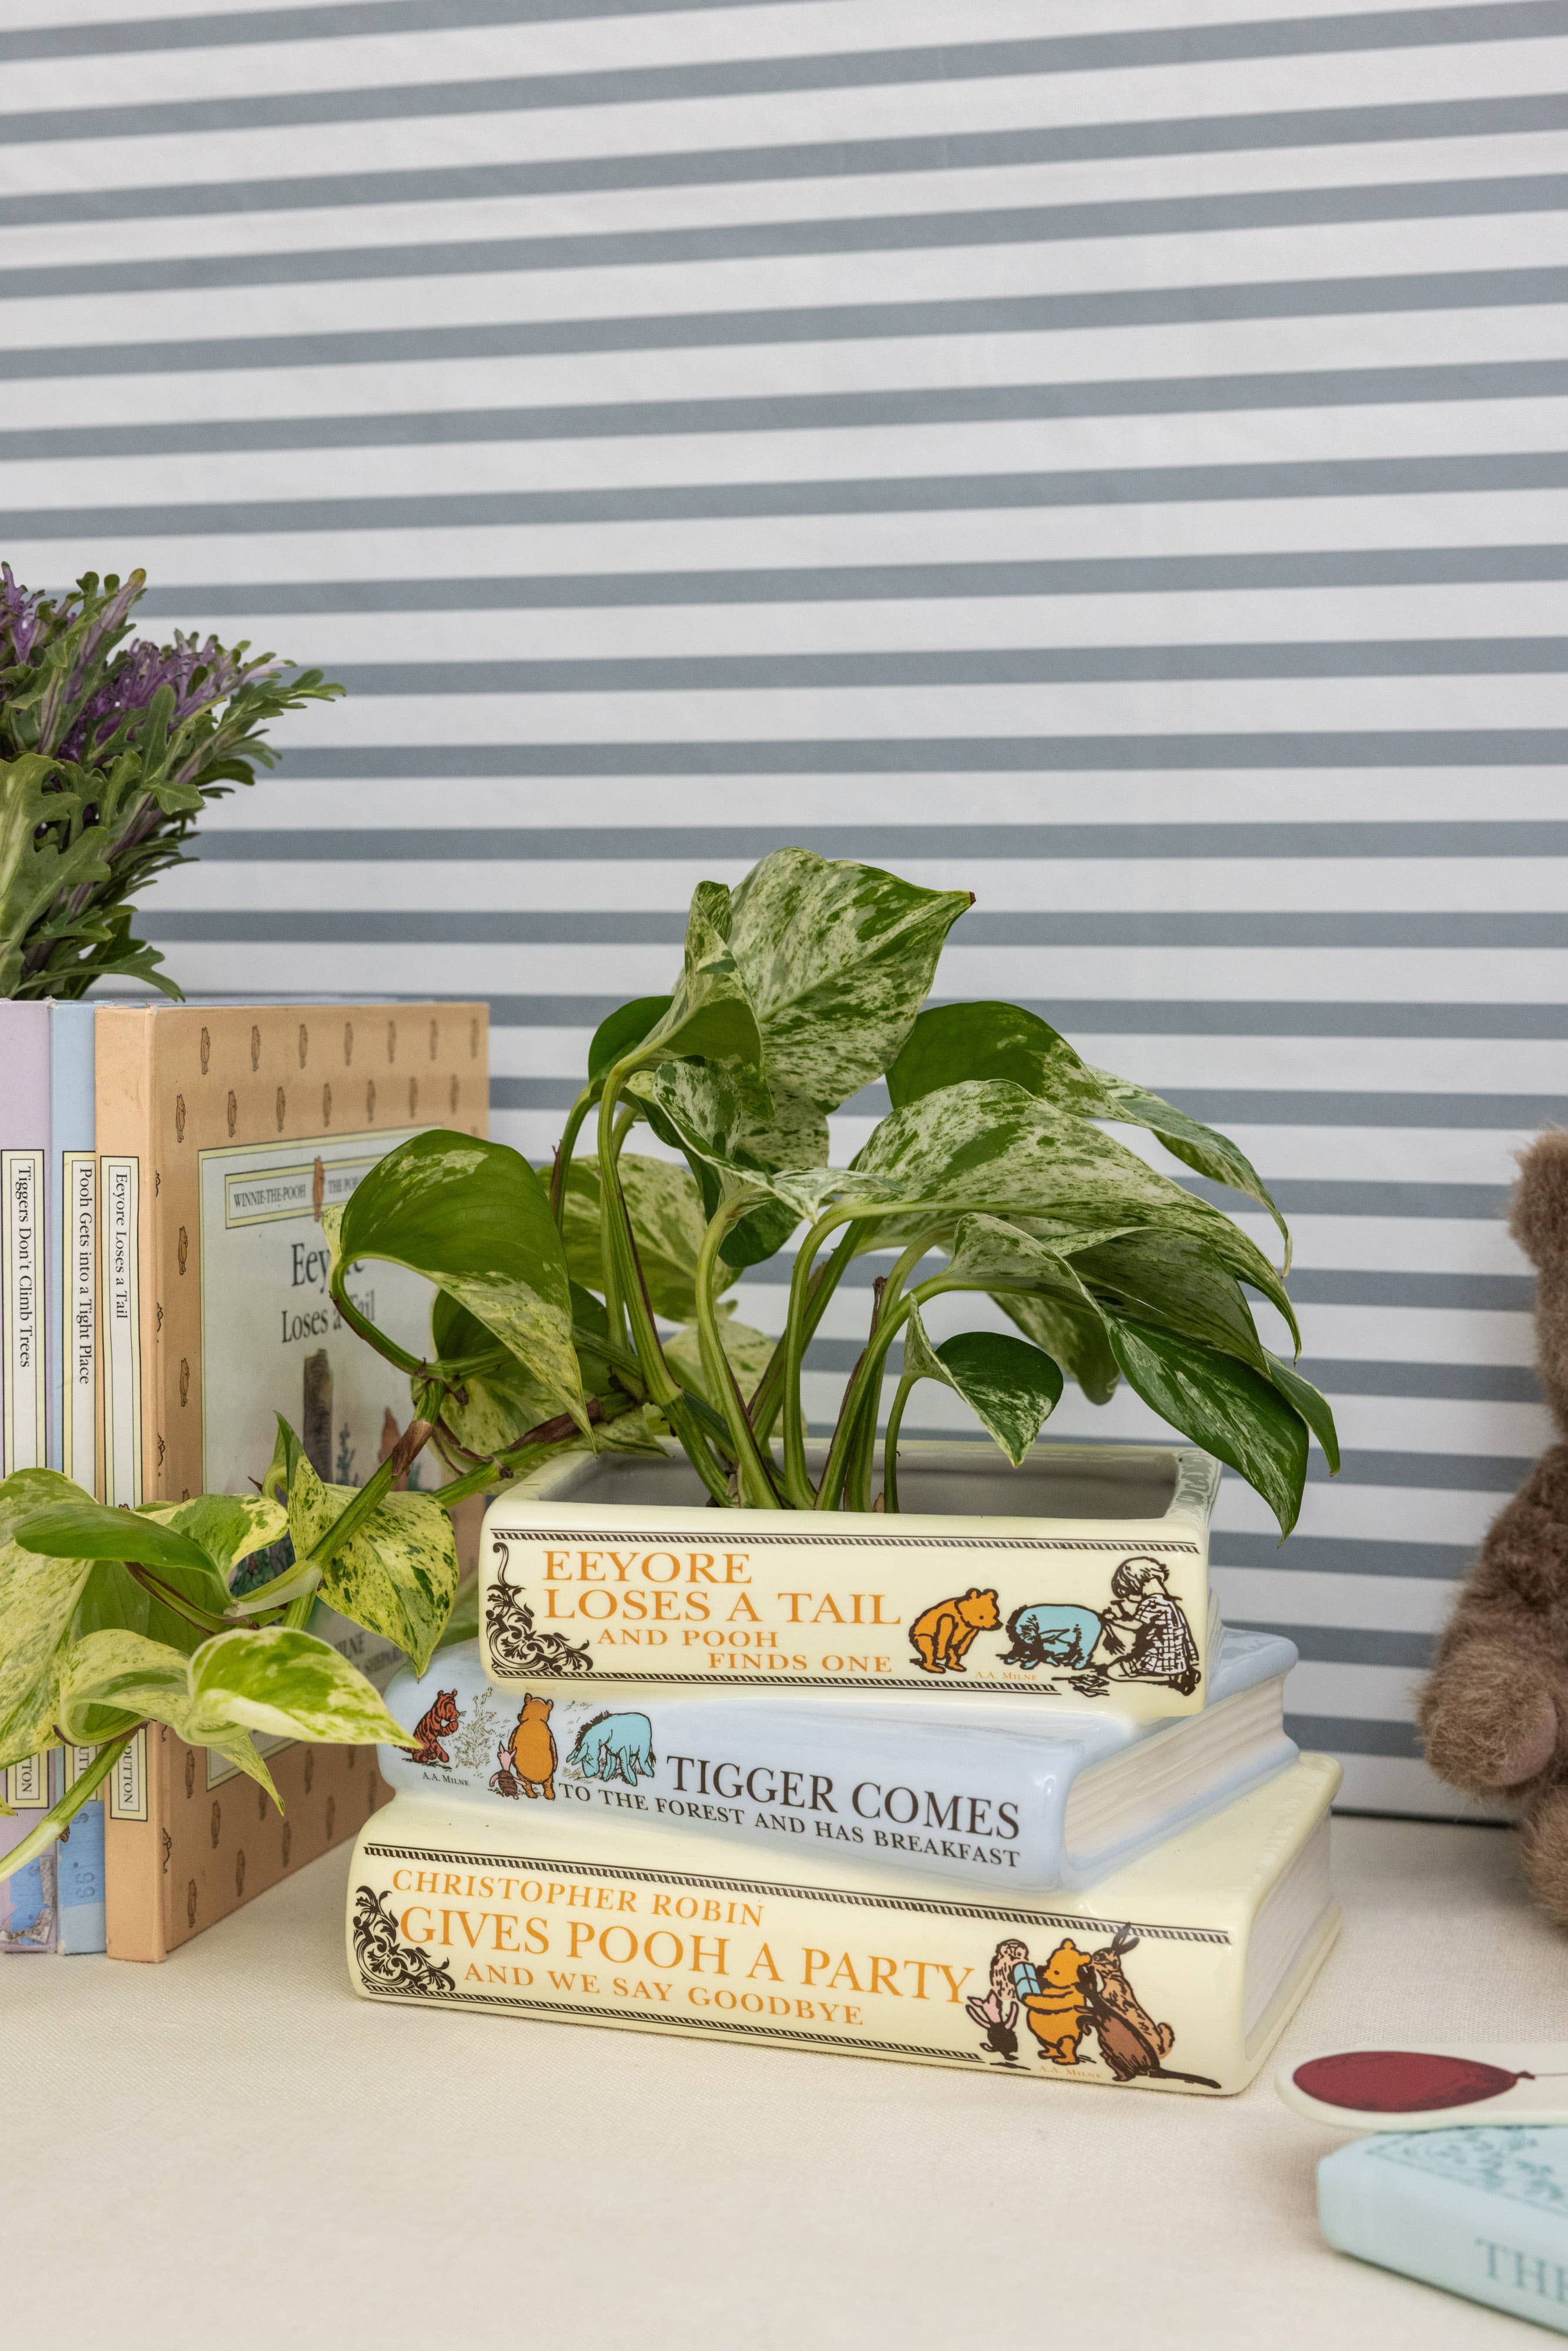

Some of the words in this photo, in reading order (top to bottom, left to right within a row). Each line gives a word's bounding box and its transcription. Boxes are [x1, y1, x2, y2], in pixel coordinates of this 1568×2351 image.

[15, 1166, 32, 1223] Tiggers
[79, 1167, 93, 1208] Pooh
[113, 1173, 128, 1226] Eeyore
[233, 1184, 306, 1208] WINNIE-THE-POOH
[79, 1212, 92, 1247] Gets
[79, 1251, 92, 1282] into
[115, 1231, 127, 1273] Loses
[19, 1275, 33, 1321] Climb
[79, 1286, 89, 1295] a
[115, 1278, 125, 1286] a
[76, 1298, 93, 1340] Tight
[116, 1290, 128, 1319] Tail
[282, 1307, 329, 1344] Loses
[20, 1325, 33, 1368] Trees
[79, 1344, 92, 1385] Place
[542, 1550, 752, 1585] EEYORE
[544, 1589, 711, 1622] LOSES
[726, 1592, 763, 1623] A
[778, 1593, 901, 1625] TAIL
[597, 1628, 668, 1646] AND
[682, 1629, 779, 1648] POOH
[708, 1652, 808, 1671] FINDS
[822, 1655, 892, 1673] ONE
[423, 1771, 441, 1782] A.A.
[666, 1755, 839, 1814] TIGGER
[852, 1781, 1020, 1840] COMES
[558, 1783, 591, 1802] TO
[598, 1789, 649, 1811] THE
[656, 1797, 746, 1826] FOREST
[754, 1812, 806, 1834] AND
[815, 1821, 865, 1844] HAS
[874, 1830, 1020, 1867] BREAKFAST
[392, 1868, 638, 1913] CHRISTOPHER
[651, 1893, 765, 1927] ROBIN
[400, 1906, 550, 1955] GIVES
[566, 1921, 732, 1975] POOH
[745, 1942, 785, 1983] A
[800, 1947, 976, 2004] PARTY
[463, 1962, 535, 1986] AND
[547, 1970, 600, 1994] WE
[613, 1978, 674, 2001] SAY
[688, 1987, 864, 2026] GOODBYE
